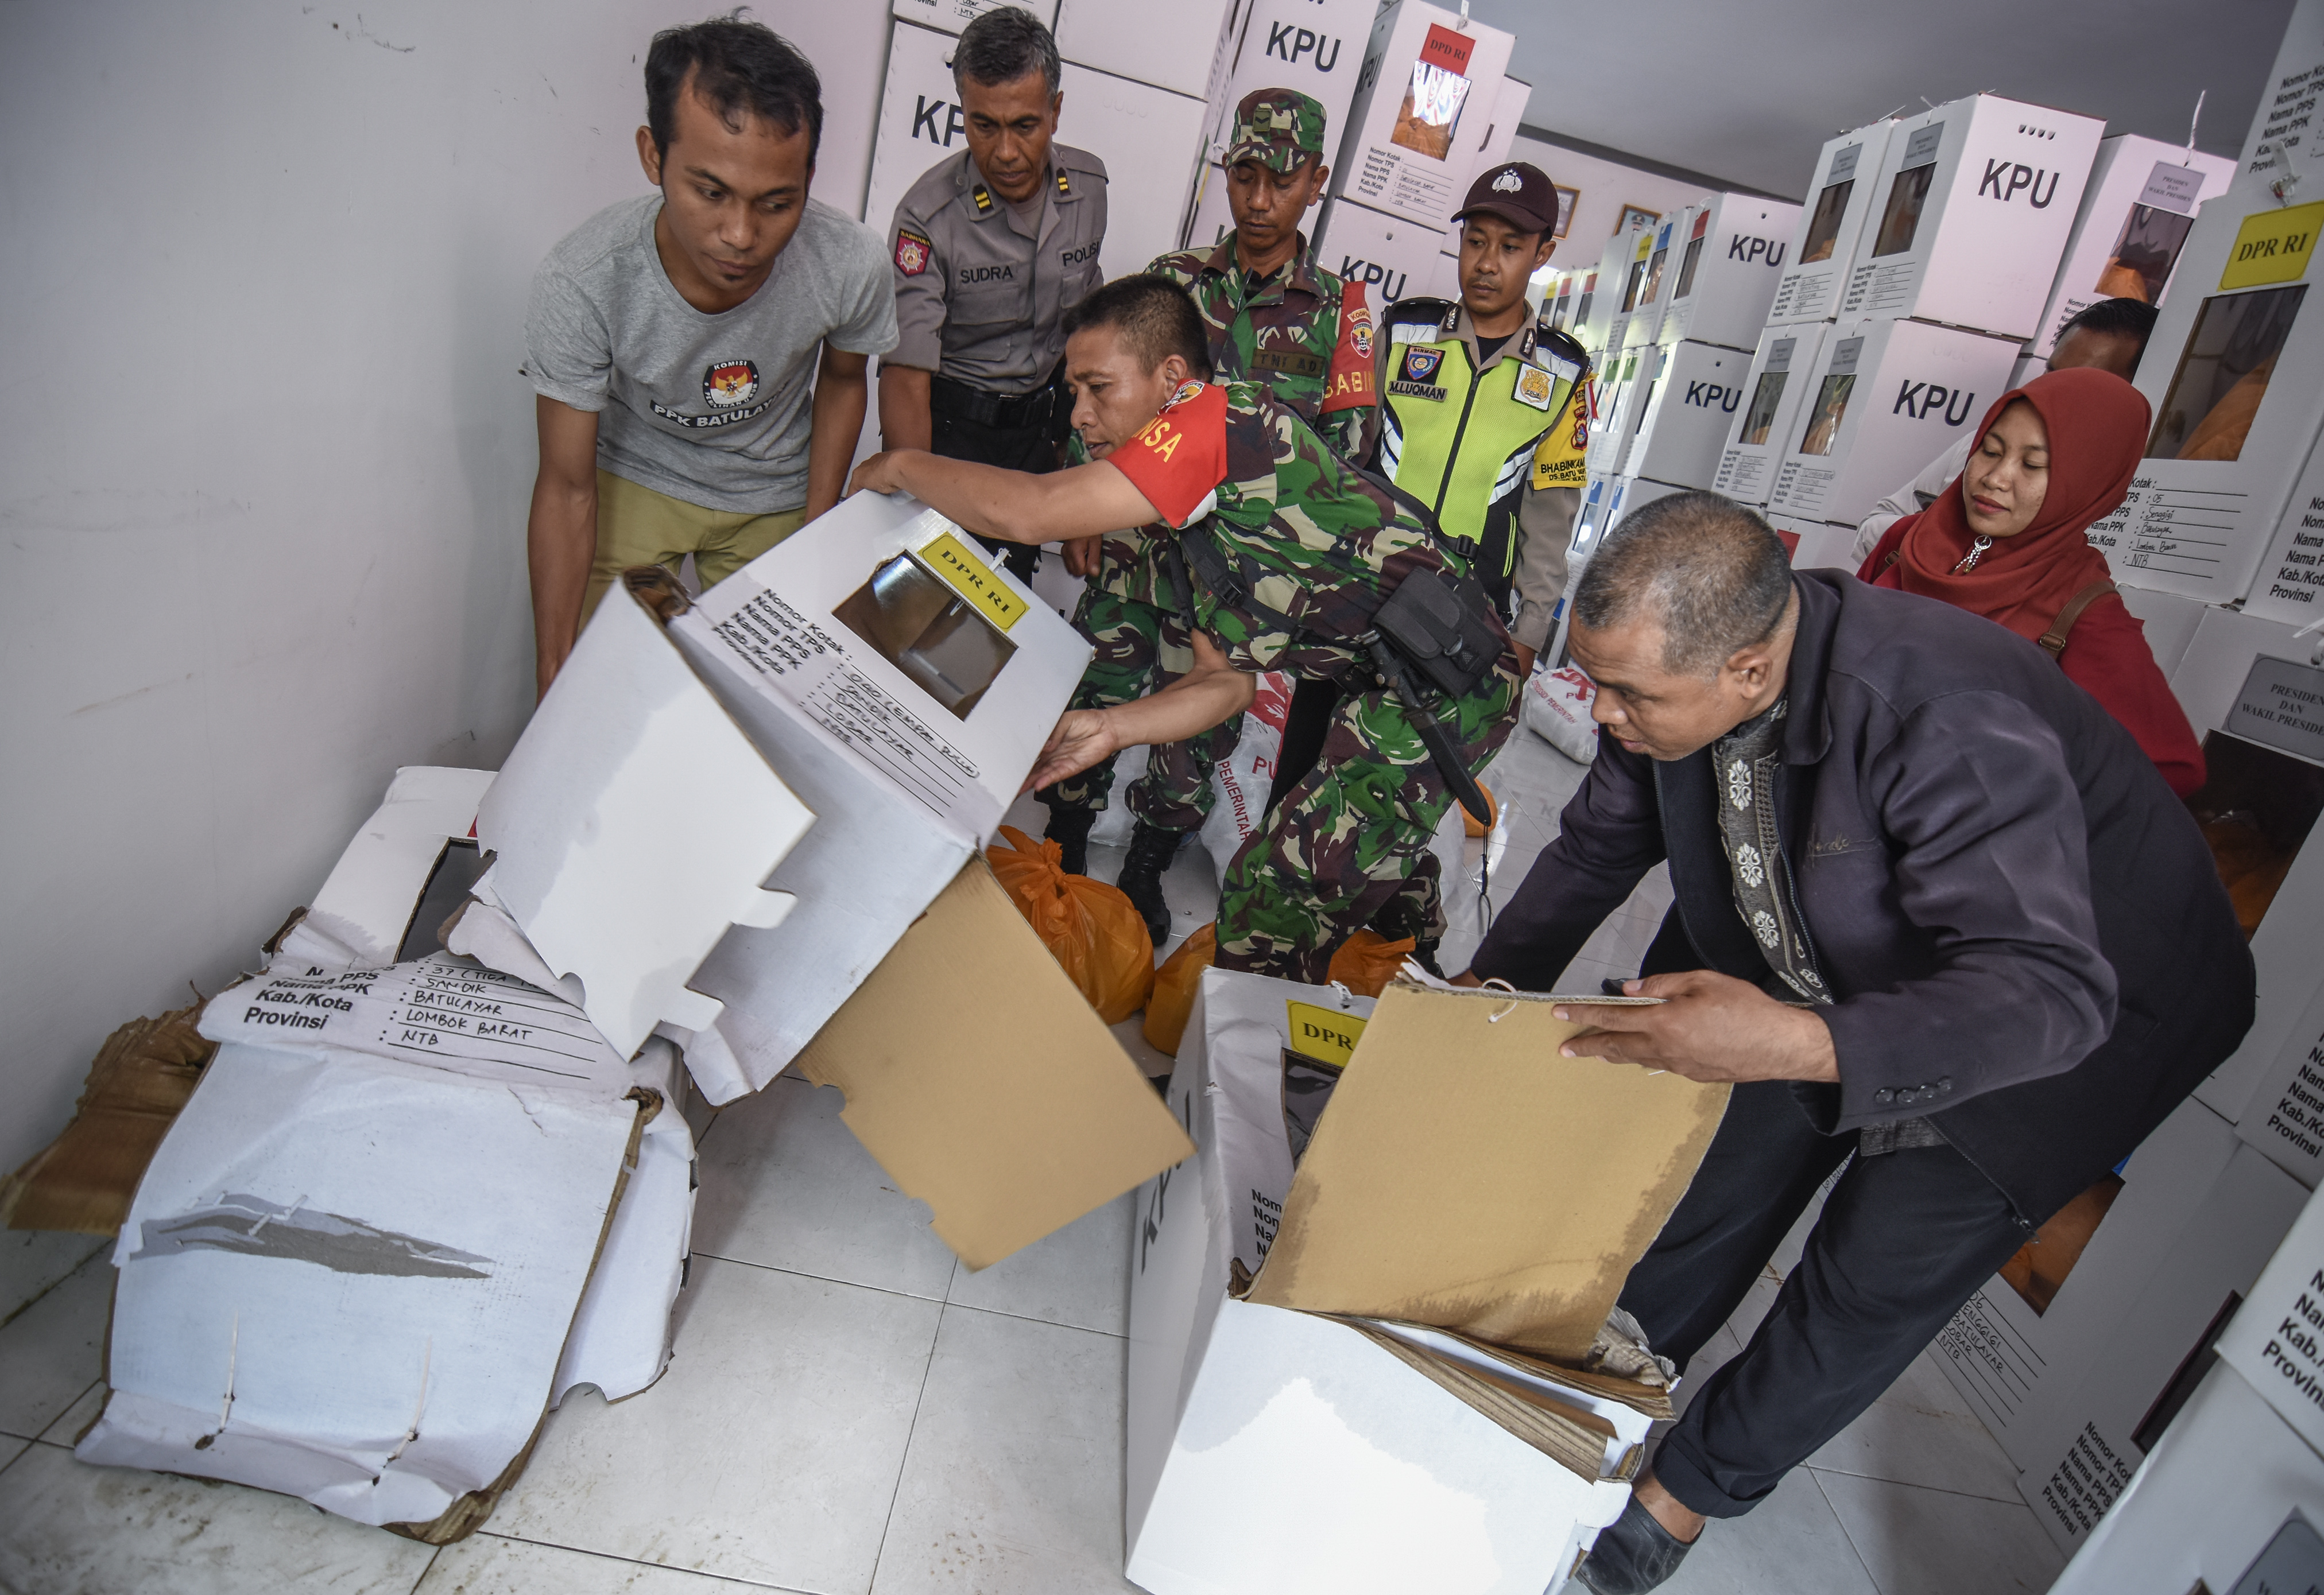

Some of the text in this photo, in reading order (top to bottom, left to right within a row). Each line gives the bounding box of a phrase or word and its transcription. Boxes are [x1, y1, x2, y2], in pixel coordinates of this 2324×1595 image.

[1265, 21, 1341, 73] KPU
[1430, 39, 1466, 61] DPD RI
[2280, 71, 2312, 90] Nomor
[2274, 88, 2305, 107] Nomor
[912, 95, 967, 148] KP
[2268, 98, 2316, 124] Nama PPS
[2261, 115, 2311, 141] Nama PPK
[1368, 155, 1395, 168] Nomor TPS
[1370, 147, 1401, 162] Nomor Kotak
[1362, 170, 1388, 183] Nama PPK
[1365, 162, 1390, 176] Nama PPS
[1358, 186, 1378, 197] Provinsi
[1360, 178, 1383, 191] Kab./Kota
[1978, 158, 2059, 209] KPU
[1062, 242, 1099, 266] POLISI
[1729, 234, 1785, 267] KPU
[2237, 232, 2310, 262] DPR RI
[961, 266, 1013, 284] SUDRA
[1341, 256, 1407, 302] KPU
[2067, 298, 2086, 308] Nomor
[714, 360, 747, 370] KOMISI
[1260, 354, 1317, 372] TNI AD
[1389, 381, 1446, 400] M.LUQMAN
[1684, 380, 1742, 413] KPU
[1892, 379, 1975, 426] KPU
[654, 398, 774, 426] PPK BATULAY
[2129, 478, 2152, 488] Kotak
[2127, 492, 2140, 503] TPS
[2153, 494, 2164, 503] 05
[2114, 507, 2131, 517] PPS
[2145, 506, 2175, 521] Senggigi
[2108, 521, 2126, 533] PPK
[2293, 533, 2324, 548] Nama
[2131, 554, 2149, 568] NTB
[2285, 550, 2316, 565] Nama
[940, 550, 1010, 614] DPR RI
[2269, 584, 2315, 603] Provinsi
[741, 603, 811, 659] Nama PPS
[752, 595, 826, 655] Nomor TPS
[762, 588, 846, 655] Nomor Kotak
[719, 620, 787, 675] Kab./Kota
[730, 611, 804, 671] Nama PPK
[1547, 697, 1577, 724] PEMERINTAH
[2242, 703, 2324, 736] WAKIL PRESIDE
[2279, 700, 2305, 715] DAN
[1217, 760, 1253, 841] PEMERINTAH
[339, 972, 380, 983] PPS
[432, 967, 455, 976] 37
[425, 979, 487, 994] SANDIK
[255, 989, 354, 1012] Kab./Kota
[414, 991, 502, 1015] BATULAYAR
[243, 1007, 330, 1030] Provinsi
[406, 1009, 533, 1040] LOMBOK BARAT
[401, 1030, 439, 1045] NTB
[1302, 1022, 1354, 1051] DPR
[2287, 1081, 2324, 1114] Nama
[2267, 1114, 2322, 1158] Provinsi
[1940, 1335, 1960, 1359] NTB
[2085, 1421, 2115, 1461] Nomor
[2076, 1434, 2106, 1474] Nomor
[2067, 1447, 2113, 1508] Nama PPS
[2051, 1473, 2092, 1531] Kab./Kota
[2059, 1460, 2105, 1522] Nama PPK
[2042, 1485, 2078, 1535] Provinsi
